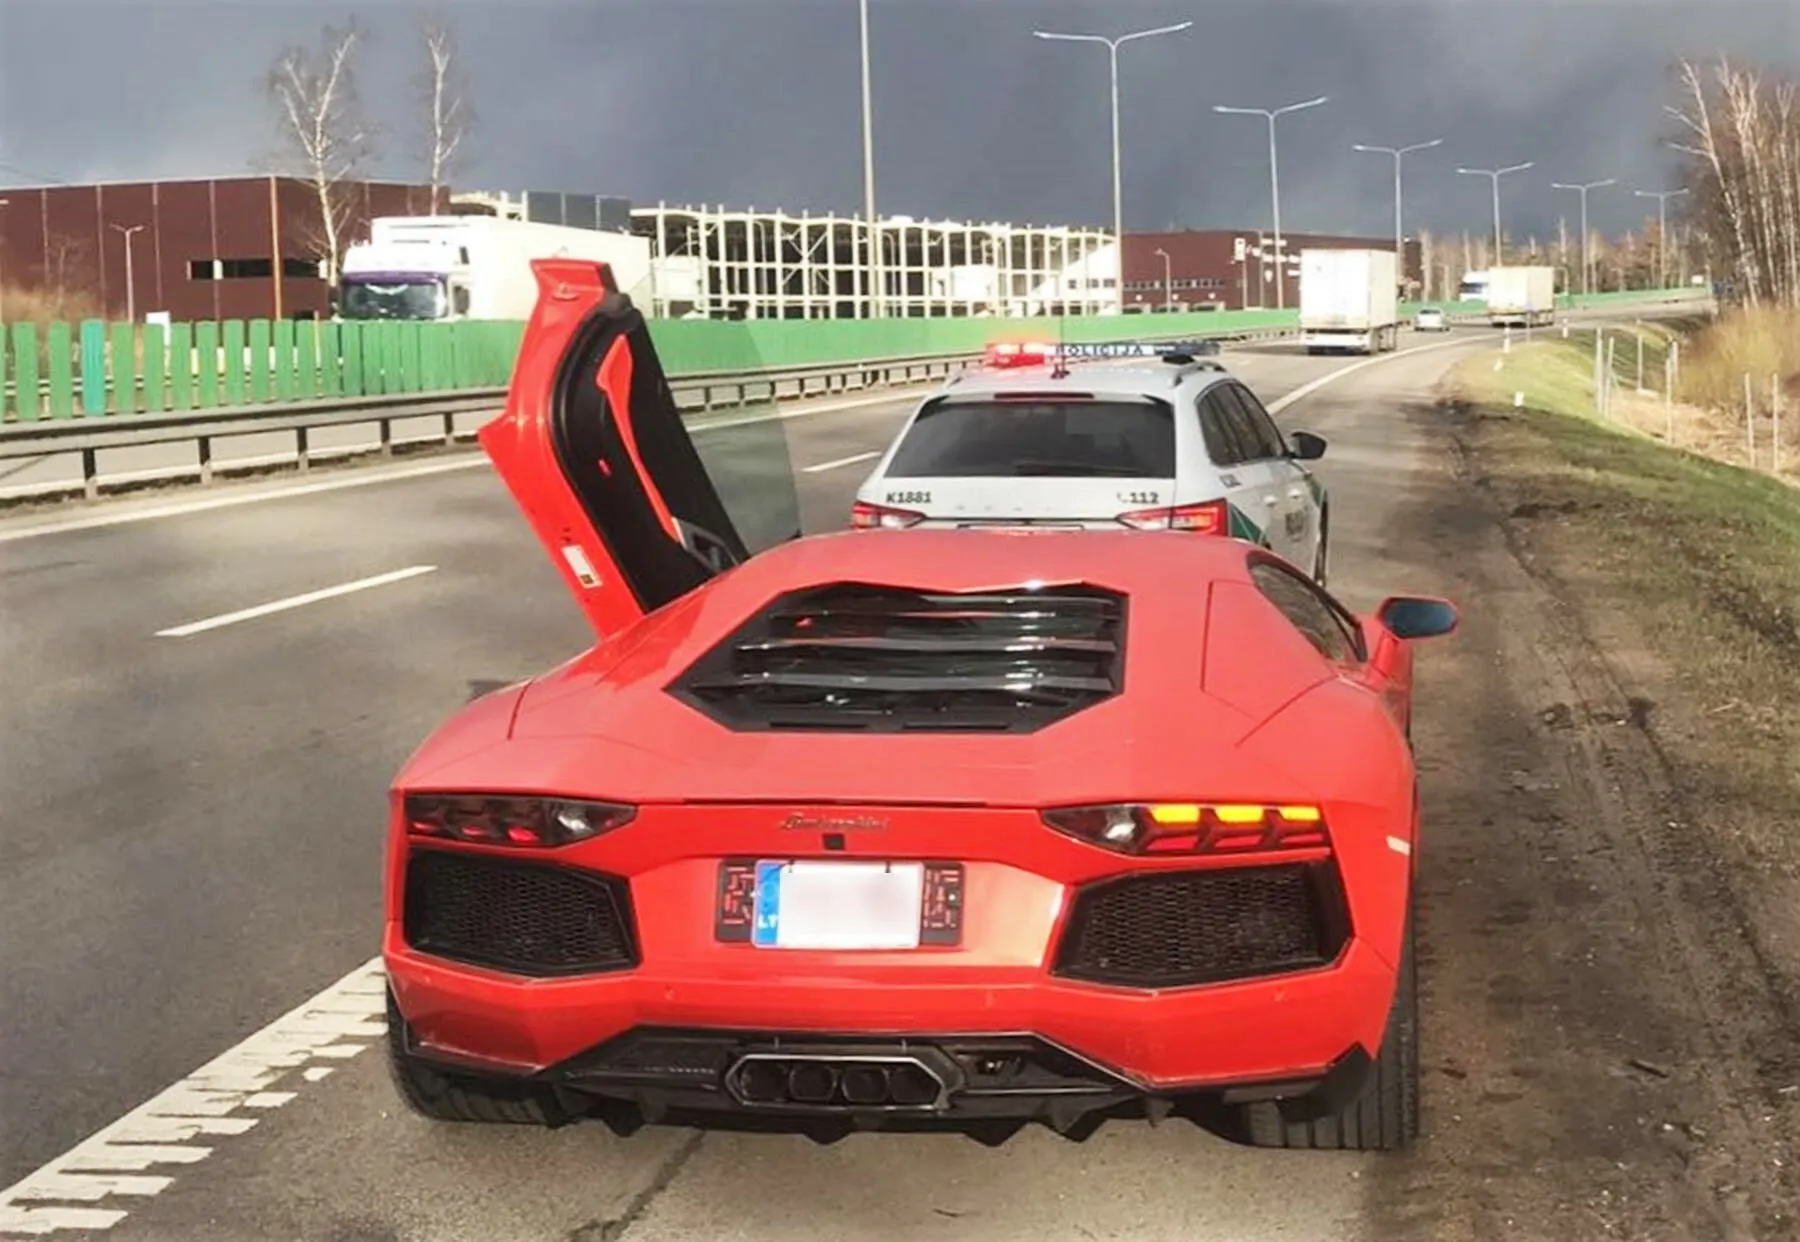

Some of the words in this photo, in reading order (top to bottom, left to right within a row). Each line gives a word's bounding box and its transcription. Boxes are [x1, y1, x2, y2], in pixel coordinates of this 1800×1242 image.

[886, 490, 932, 504] K1881
[1129, 491, 1159, 504] 112
[757, 914, 778, 928] LT
